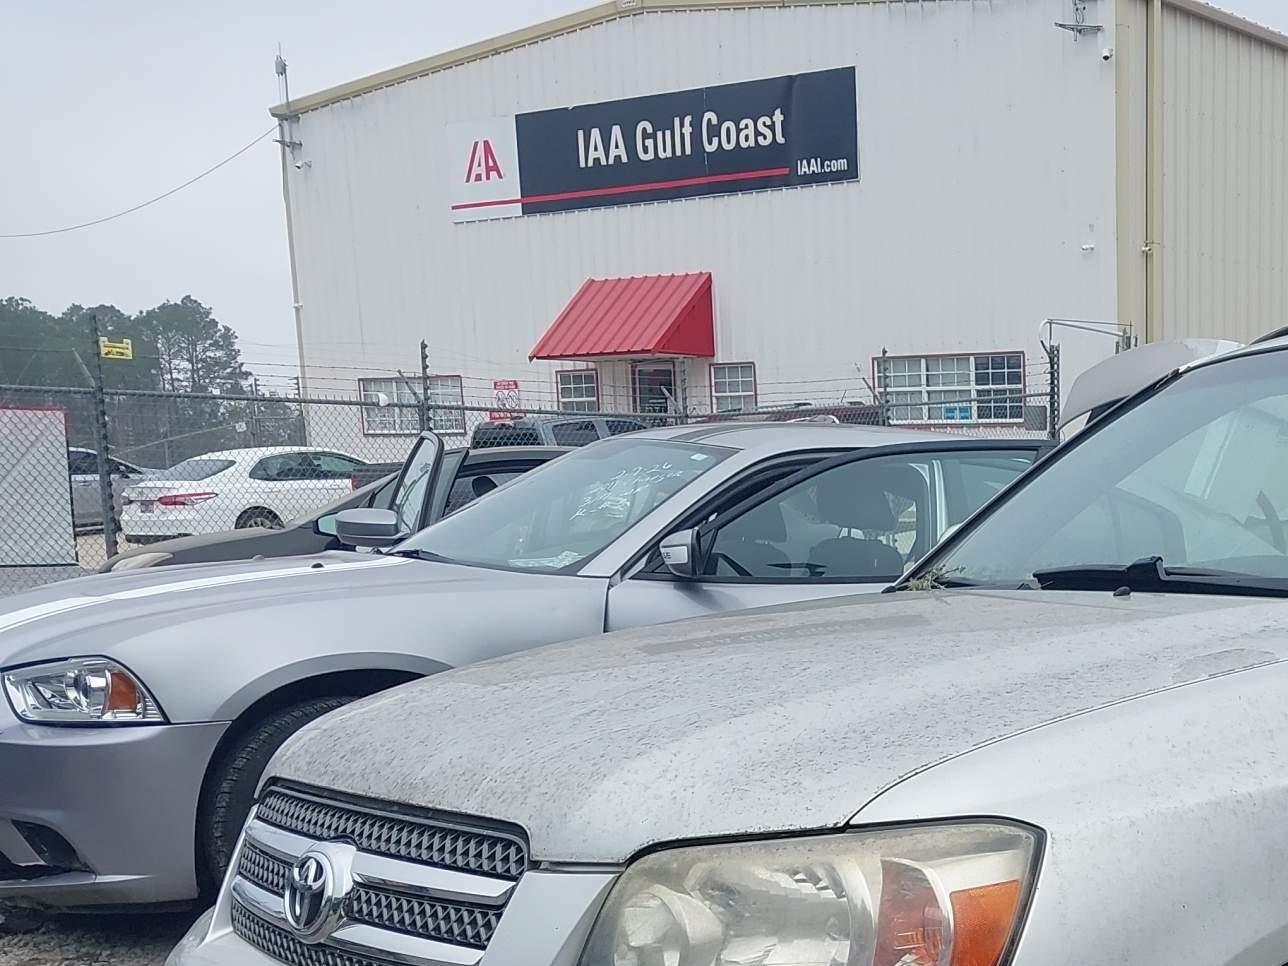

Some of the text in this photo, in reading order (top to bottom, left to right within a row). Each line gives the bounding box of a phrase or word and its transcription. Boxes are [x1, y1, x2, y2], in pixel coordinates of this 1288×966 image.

[577, 107, 785, 169] IAA Gulf Coast
[797, 157, 848, 177] IAAI.com
